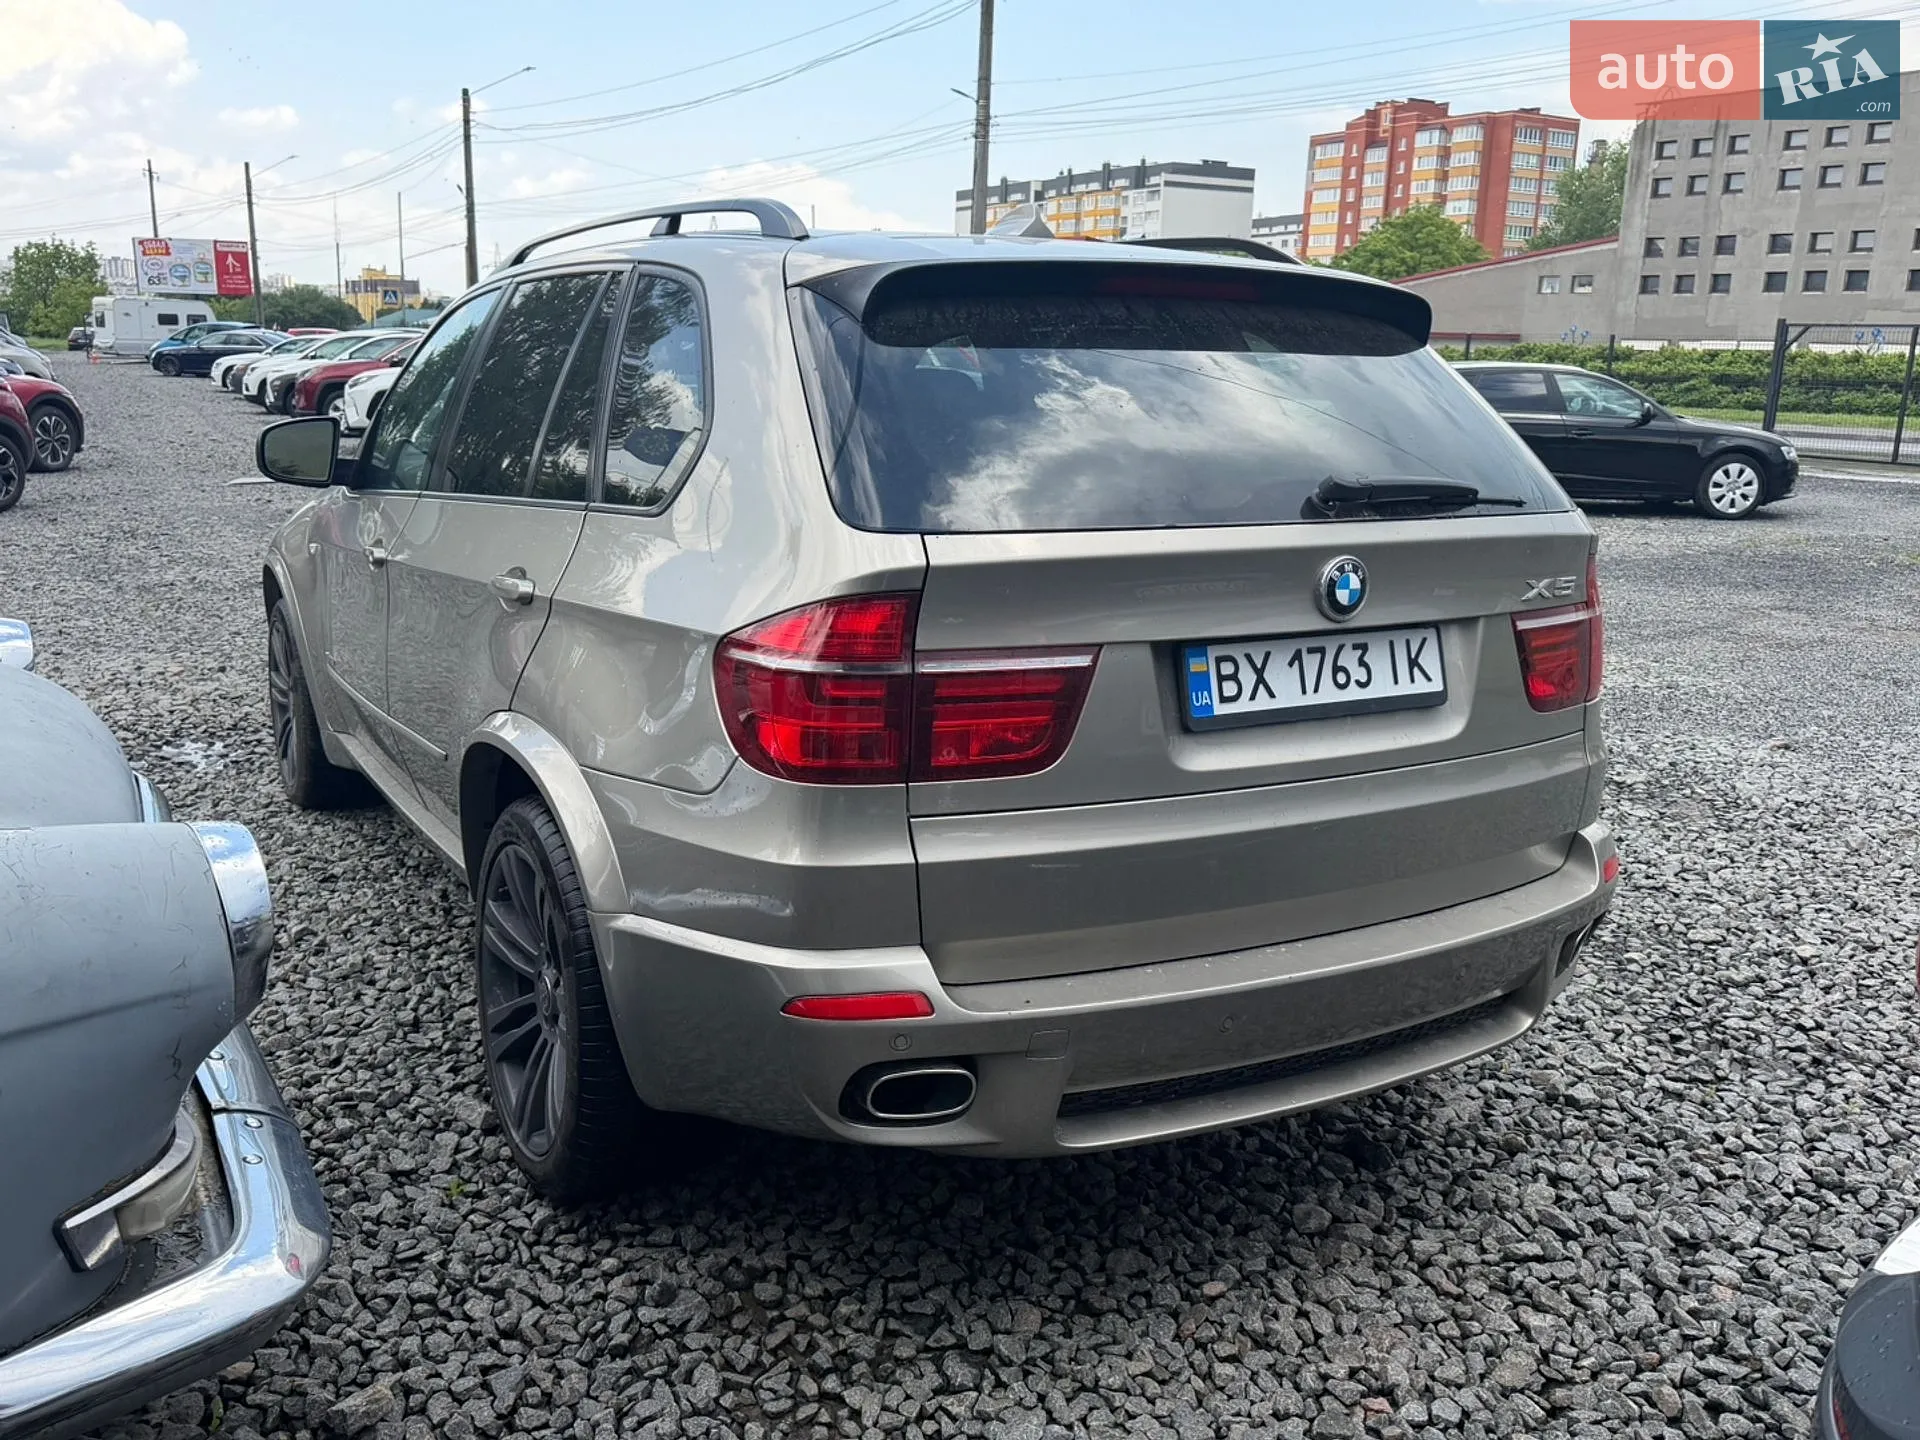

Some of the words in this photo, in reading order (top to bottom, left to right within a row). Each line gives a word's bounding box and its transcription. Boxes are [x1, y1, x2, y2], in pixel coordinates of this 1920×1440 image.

[1330, 562, 1364, 581] BMW
[1520, 575, 1577, 602] X5
[1214, 650, 1277, 704] BX
[1287, 641, 1373, 696] 1763
[1388, 636, 1433, 685] IK
[1191, 690, 1212, 707] UA
